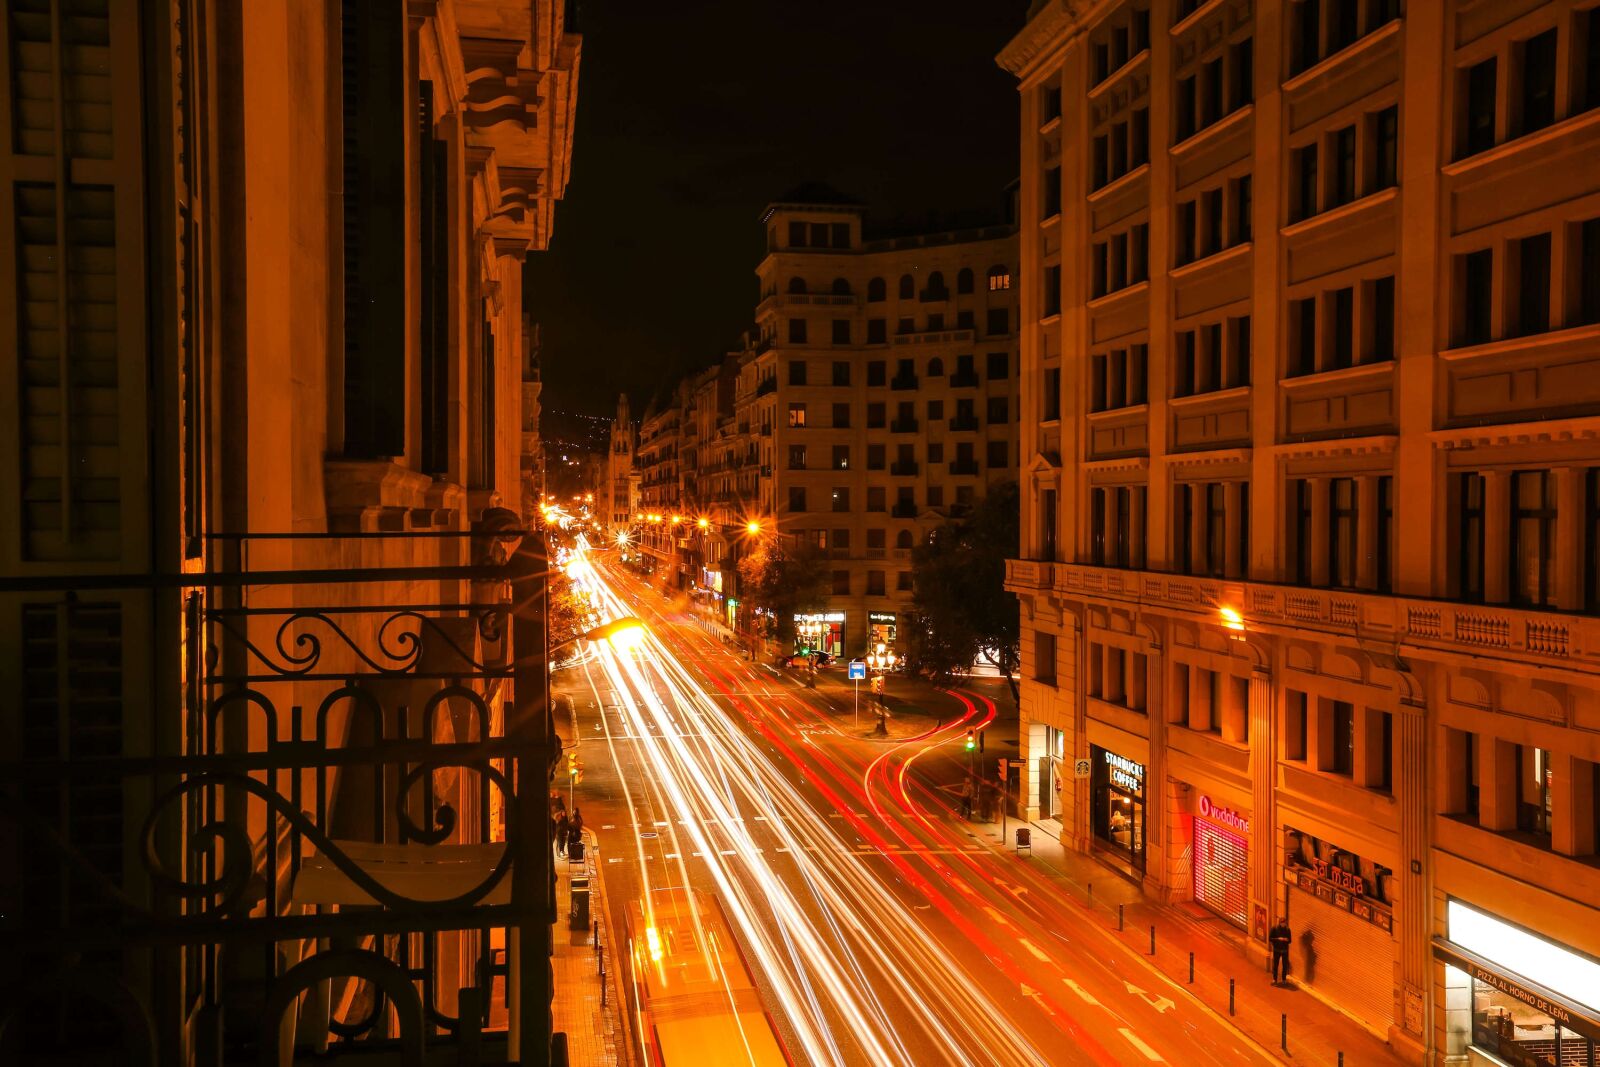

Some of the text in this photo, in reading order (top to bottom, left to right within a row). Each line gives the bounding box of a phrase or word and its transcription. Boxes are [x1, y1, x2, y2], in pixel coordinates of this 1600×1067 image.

[1105, 751, 1143, 776] STARBUCKS
[1113, 769, 1138, 791] COFFEE
[1477, 970, 1570, 1023] PIZZA AL HORNO DE LEÑA
